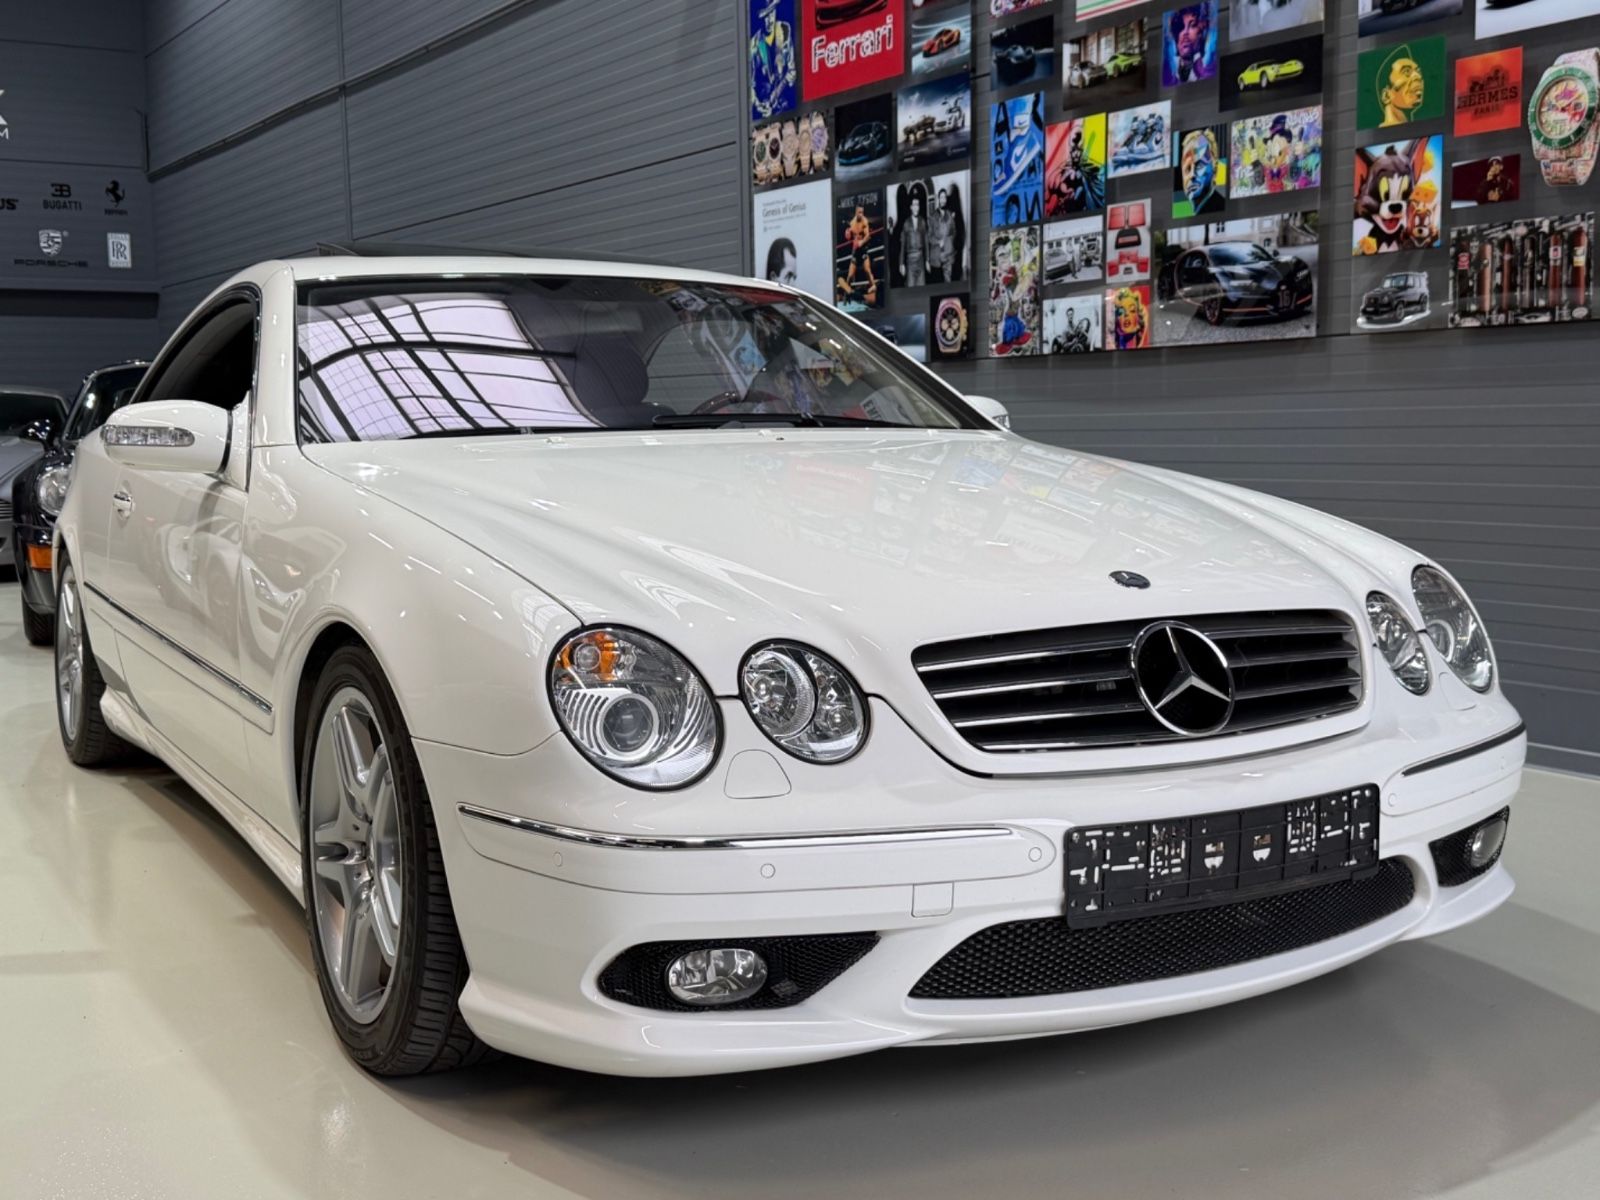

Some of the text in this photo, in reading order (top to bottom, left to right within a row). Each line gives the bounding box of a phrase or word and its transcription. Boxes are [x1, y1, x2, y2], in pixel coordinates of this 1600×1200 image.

[811, 13, 894, 73] Ferrari
[42, 199, 83, 211] BUGATTI
[14, 258, 88, 268] PORSCHE
